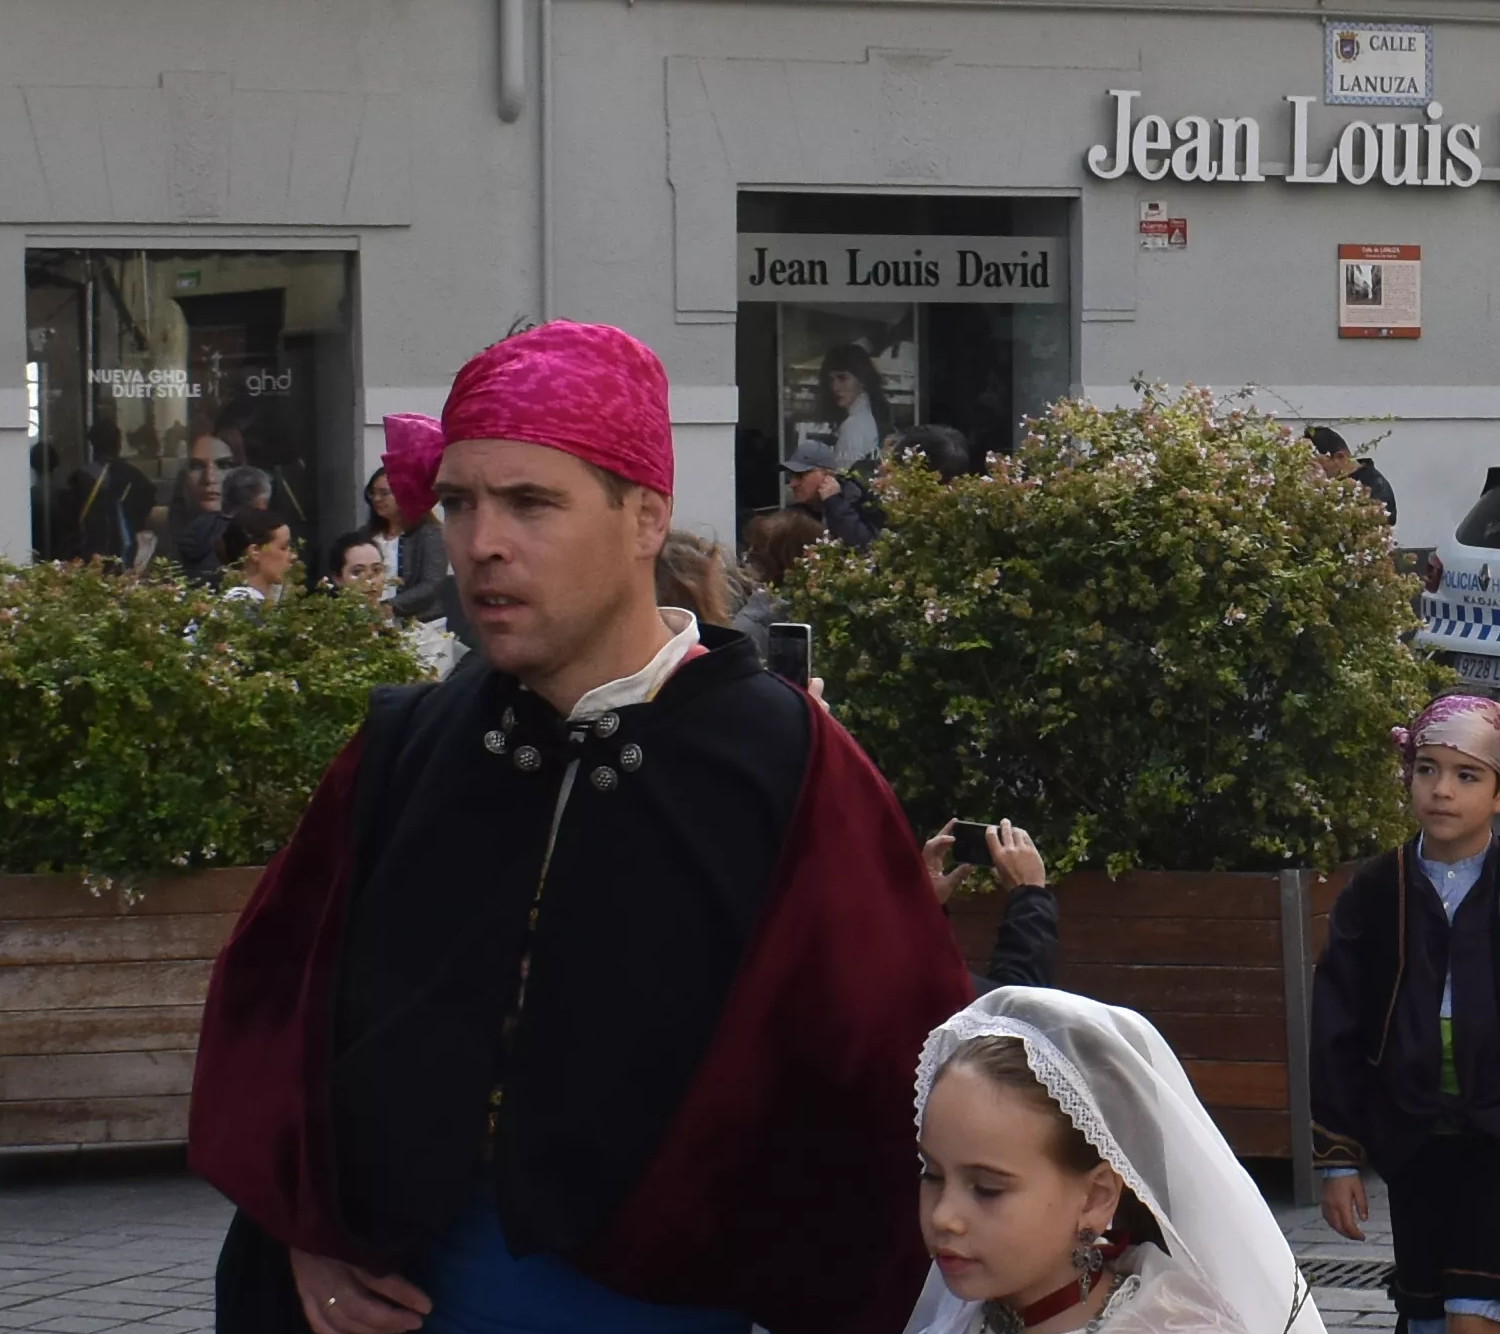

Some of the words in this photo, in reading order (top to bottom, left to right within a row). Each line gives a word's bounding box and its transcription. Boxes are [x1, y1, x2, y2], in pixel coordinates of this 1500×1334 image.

[1368, 34, 1417, 53] CALLE
[1338, 73, 1419, 96] LANUZA
[1087, 88, 1265, 182] Jean
[1283, 95, 1482, 188] Louis
[749, 247, 829, 287] Jean
[845, 248, 940, 287] Louis
[956, 249, 1050, 289] David
[87, 369, 144, 384] NUEVA
[147, 369, 188, 384] GHD
[245, 368, 292, 397] ghd
[112, 383, 152, 398] DUET
[156, 383, 201, 398] STYLE
[1460, 657, 1492, 679] 9728
